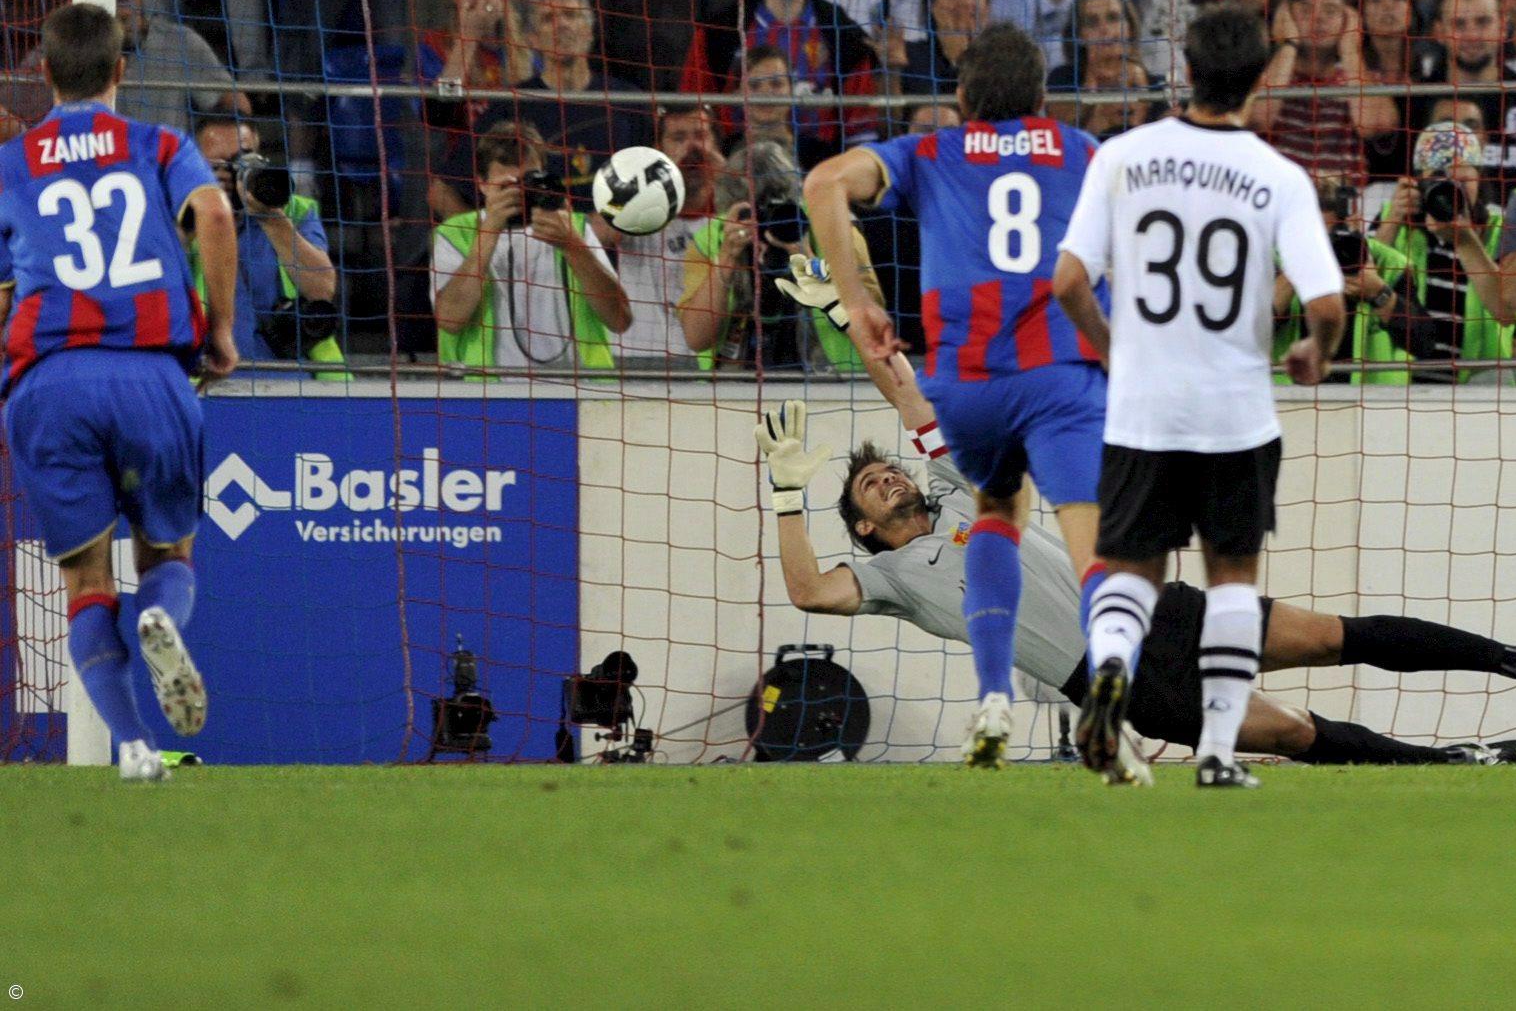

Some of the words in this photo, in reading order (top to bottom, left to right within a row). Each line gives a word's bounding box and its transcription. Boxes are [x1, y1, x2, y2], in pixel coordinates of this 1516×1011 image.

[38, 130, 115, 165] ZANNI
[964, 128, 1062, 158] HUGGEL
[1126, 157, 1271, 211] MARQUINHO
[37, 171, 163, 290] 32
[988, 171, 1041, 274] 8
[1134, 209, 1249, 331] 39
[295, 447, 517, 512] Basler
[295, 517, 502, 549] Versicherungen
